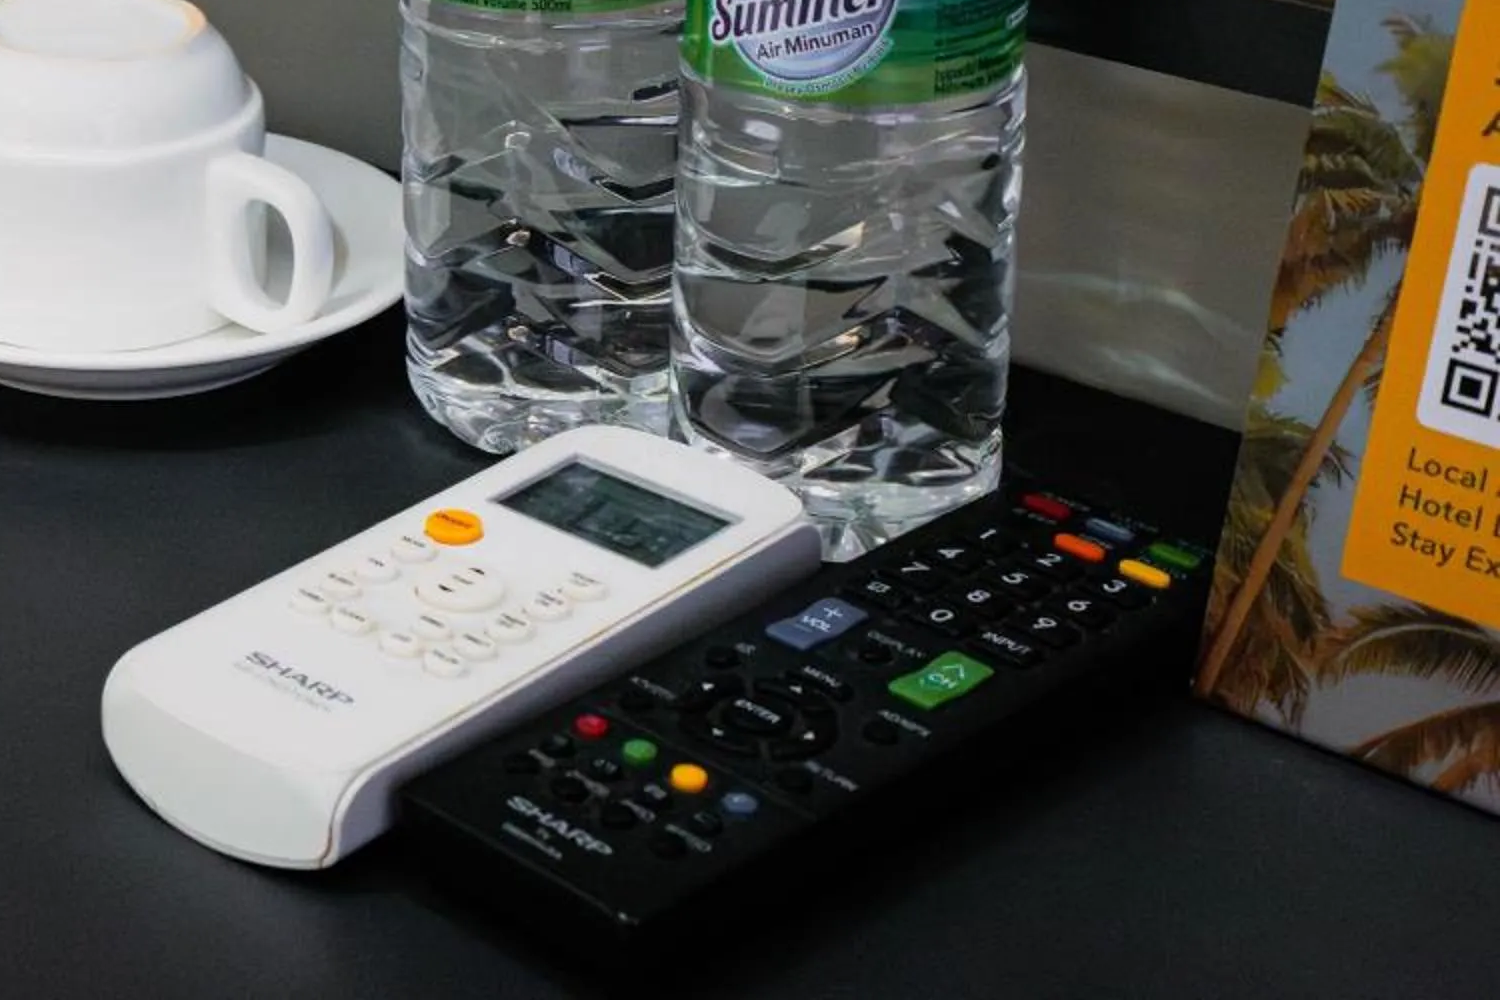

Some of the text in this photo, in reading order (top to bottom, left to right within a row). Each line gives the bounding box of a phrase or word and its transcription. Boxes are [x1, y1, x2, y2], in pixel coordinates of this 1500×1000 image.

[756, 22, 875, 61] Air Minuman
[1407, 446, 1488, 493] Local
[1399, 483, 1483, 532] Hotel
[979, 528, 1128, 594] 1 2 3
[1390, 521, 1456, 568] Stay
[901, 560, 1057, 630] 7 8 9
[937, 548, 1092, 613] 4 5 6
[802, 614, 832, 633] VOL
[929, 608, 1032, 655] 0 INPUT
[243, 649, 356, 705] SHARP
[803, 664, 843, 689] MENU
[733, 698, 783, 725] ENTER
[506, 794, 614, 856] SHARP
